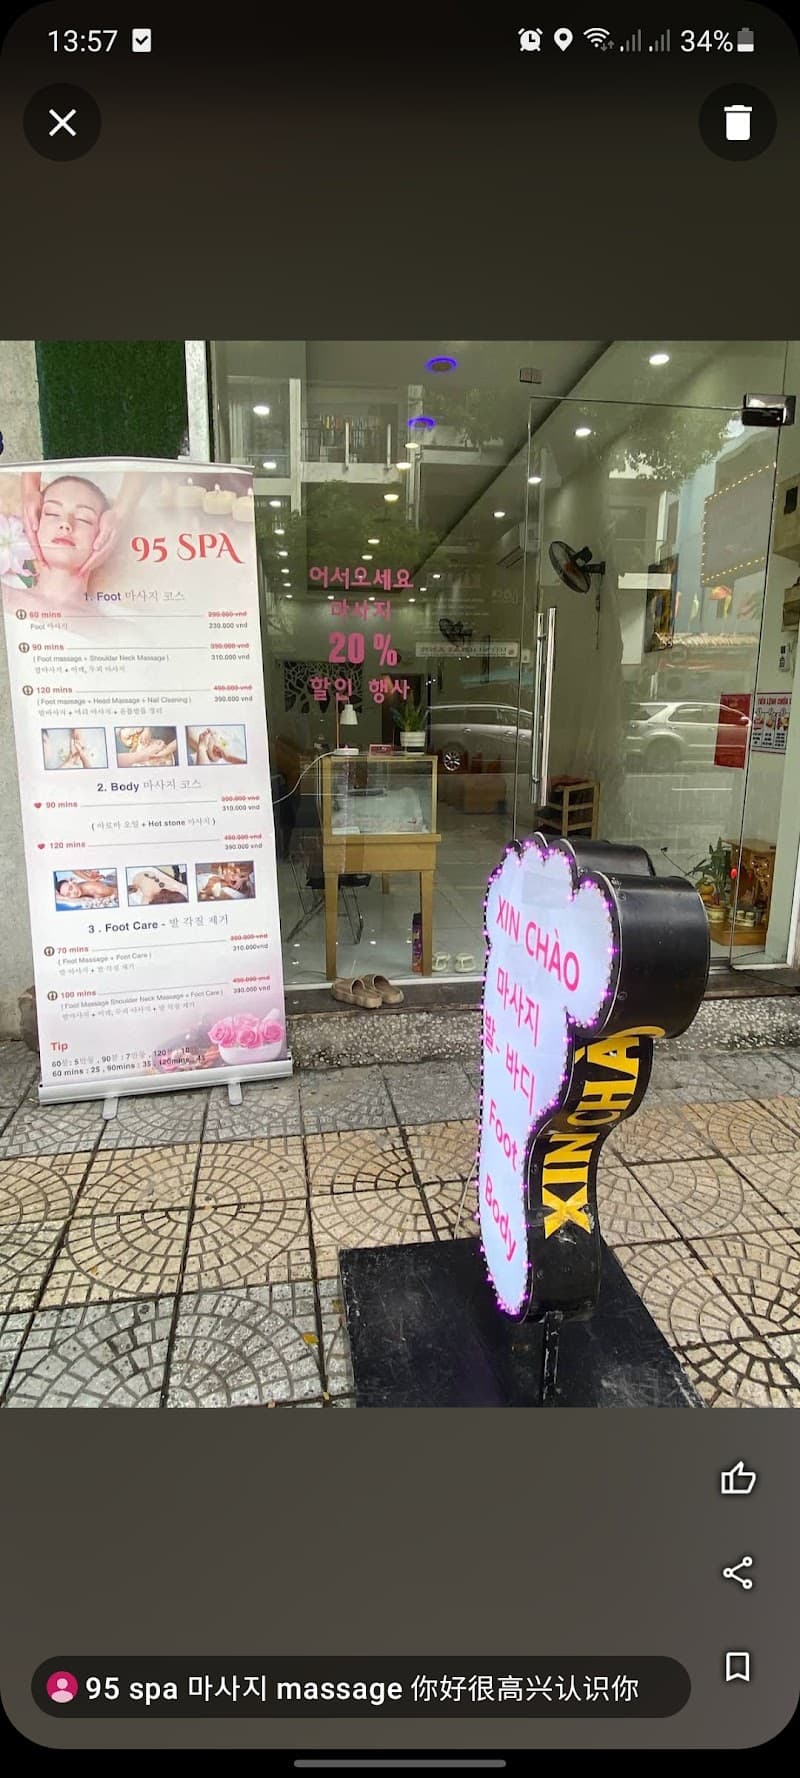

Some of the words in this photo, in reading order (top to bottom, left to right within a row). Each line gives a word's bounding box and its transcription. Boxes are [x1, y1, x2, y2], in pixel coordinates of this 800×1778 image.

[131, 536, 168, 563] 95
[177, 532, 246, 564] SPA
[309, 566, 414, 591] 어서오세요
[84, 592, 94, 601] 1.
[97, 592, 121, 601] Foot
[125, 590, 159, 601] 마사지
[163, 591, 185, 601] 코스
[42, 610, 61, 618] mins
[330, 599, 391, 621] 마사지
[44, 643, 65, 651] mins
[328, 632, 366, 664] 20
[373, 633, 398, 667] %
[53, 686, 72, 694] mins
[310, 676, 353, 702] 할인
[368, 679, 410, 704] 행사
[97, 783, 107, 792] 2.
[110, 782, 140, 792] Body
[144, 779, 176, 791] 마사지
[180, 780, 202, 790] 코스
[88, 925, 94, 933] 3
[106, 922, 130, 932] Foot
[133, 920, 158, 930] Care
[170, 917, 179, 928] 발
[184, 916, 204, 926] 각질
[209, 914, 228, 925] 제거
[496, 895, 521, 943] XIN
[525, 921, 580, 992] CHÀO
[77, 990, 96, 998] mins
[497, 967, 541, 1048] 마사지
[51, 1042, 68, 1052] Tip
[107, 1063, 136, 1072] 90mins
[505, 1043, 535, 1116] 바디
[489, 1099, 518, 1171] Foot
[542, 1133, 600, 1239] XIN
[485, 1172, 517, 1262] Body
